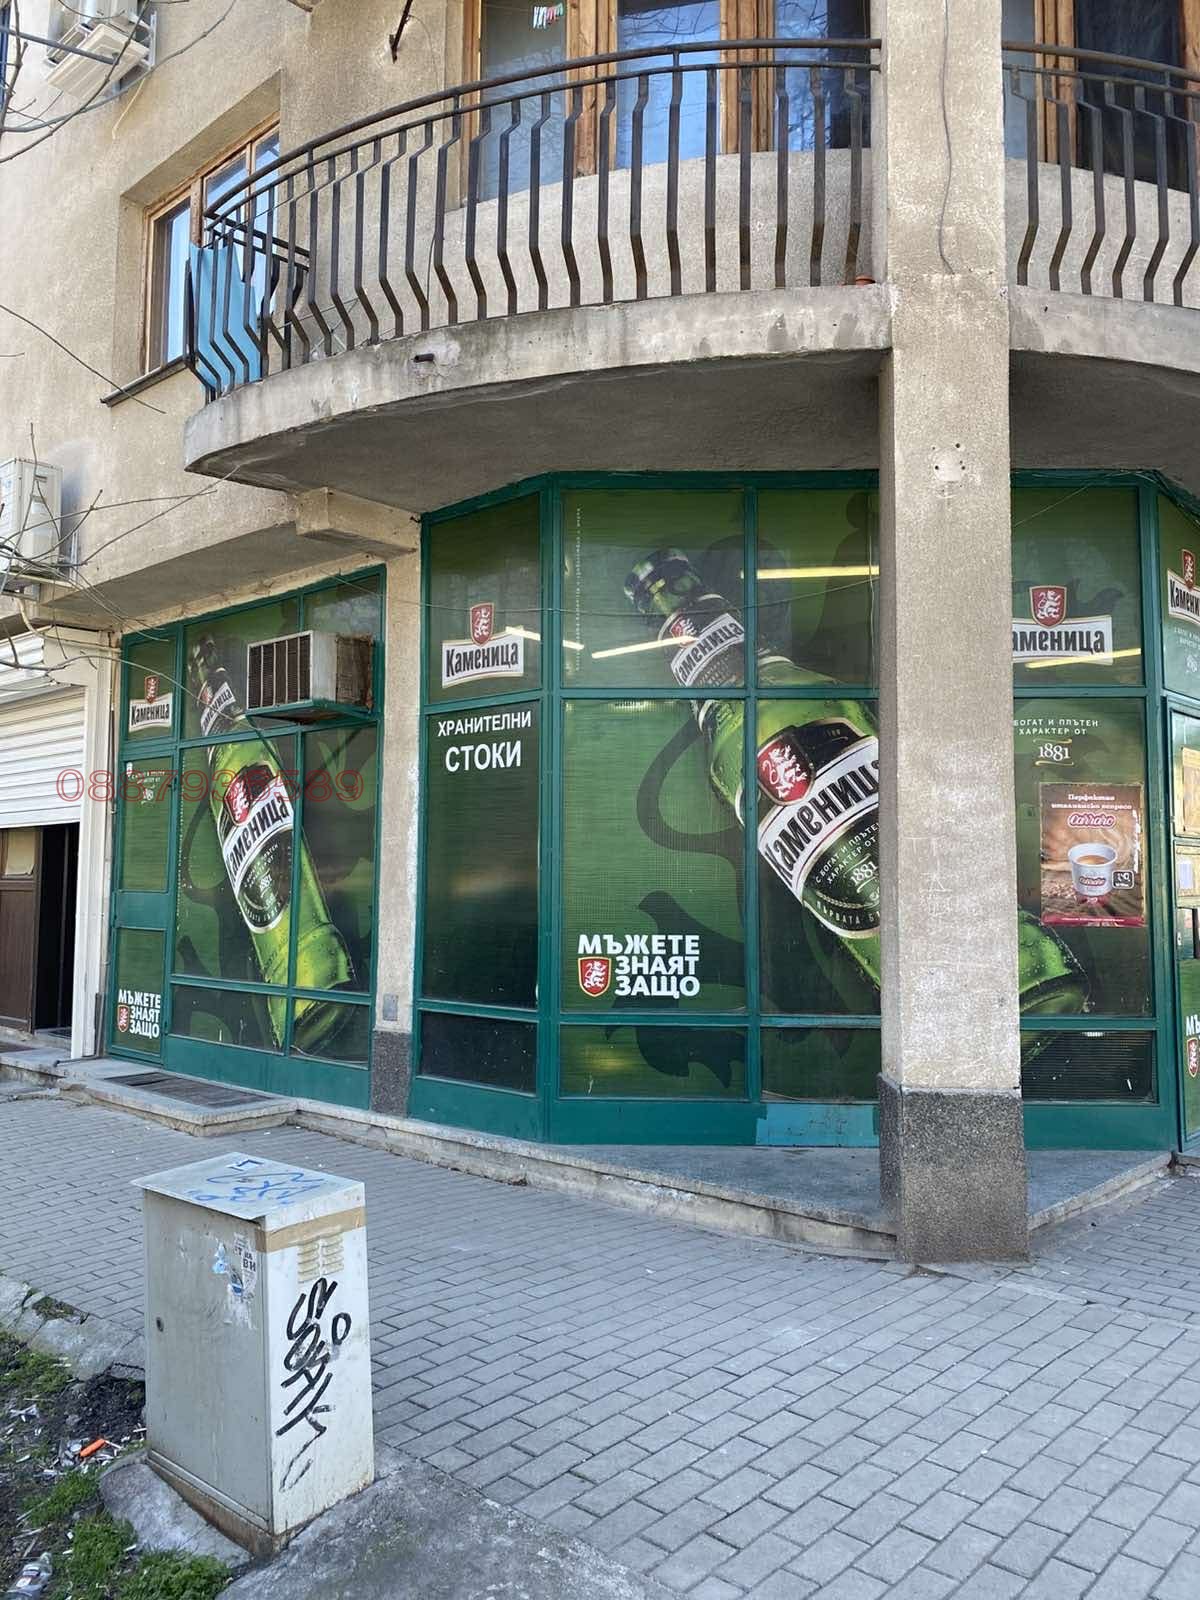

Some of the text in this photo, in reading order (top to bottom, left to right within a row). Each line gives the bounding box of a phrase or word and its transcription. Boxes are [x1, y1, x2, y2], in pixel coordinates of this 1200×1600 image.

[446, 642, 519, 677] Каменица
[131, 703, 169, 726] Каменица
[438, 710, 532, 737] ХРАНИТЕЛНИ
[1019, 727, 1070, 735] ХАРАКТЕР
[445, 740, 521, 772] СТОКИ
[1038, 742, 1071, 762] 1881
[850, 861, 878, 887] 1881
[578, 934, 700, 954] МЪЖЕТЕ
[615, 955, 699, 975] ЗНАЯТ
[615, 975, 700, 999] ЗАЩО
[118, 989, 161, 1009] МЪЖЕТЕ
[129, 1005, 160, 1023] ЗНАЯТ
[129, 1019, 160, 1039] ЗАЩО
